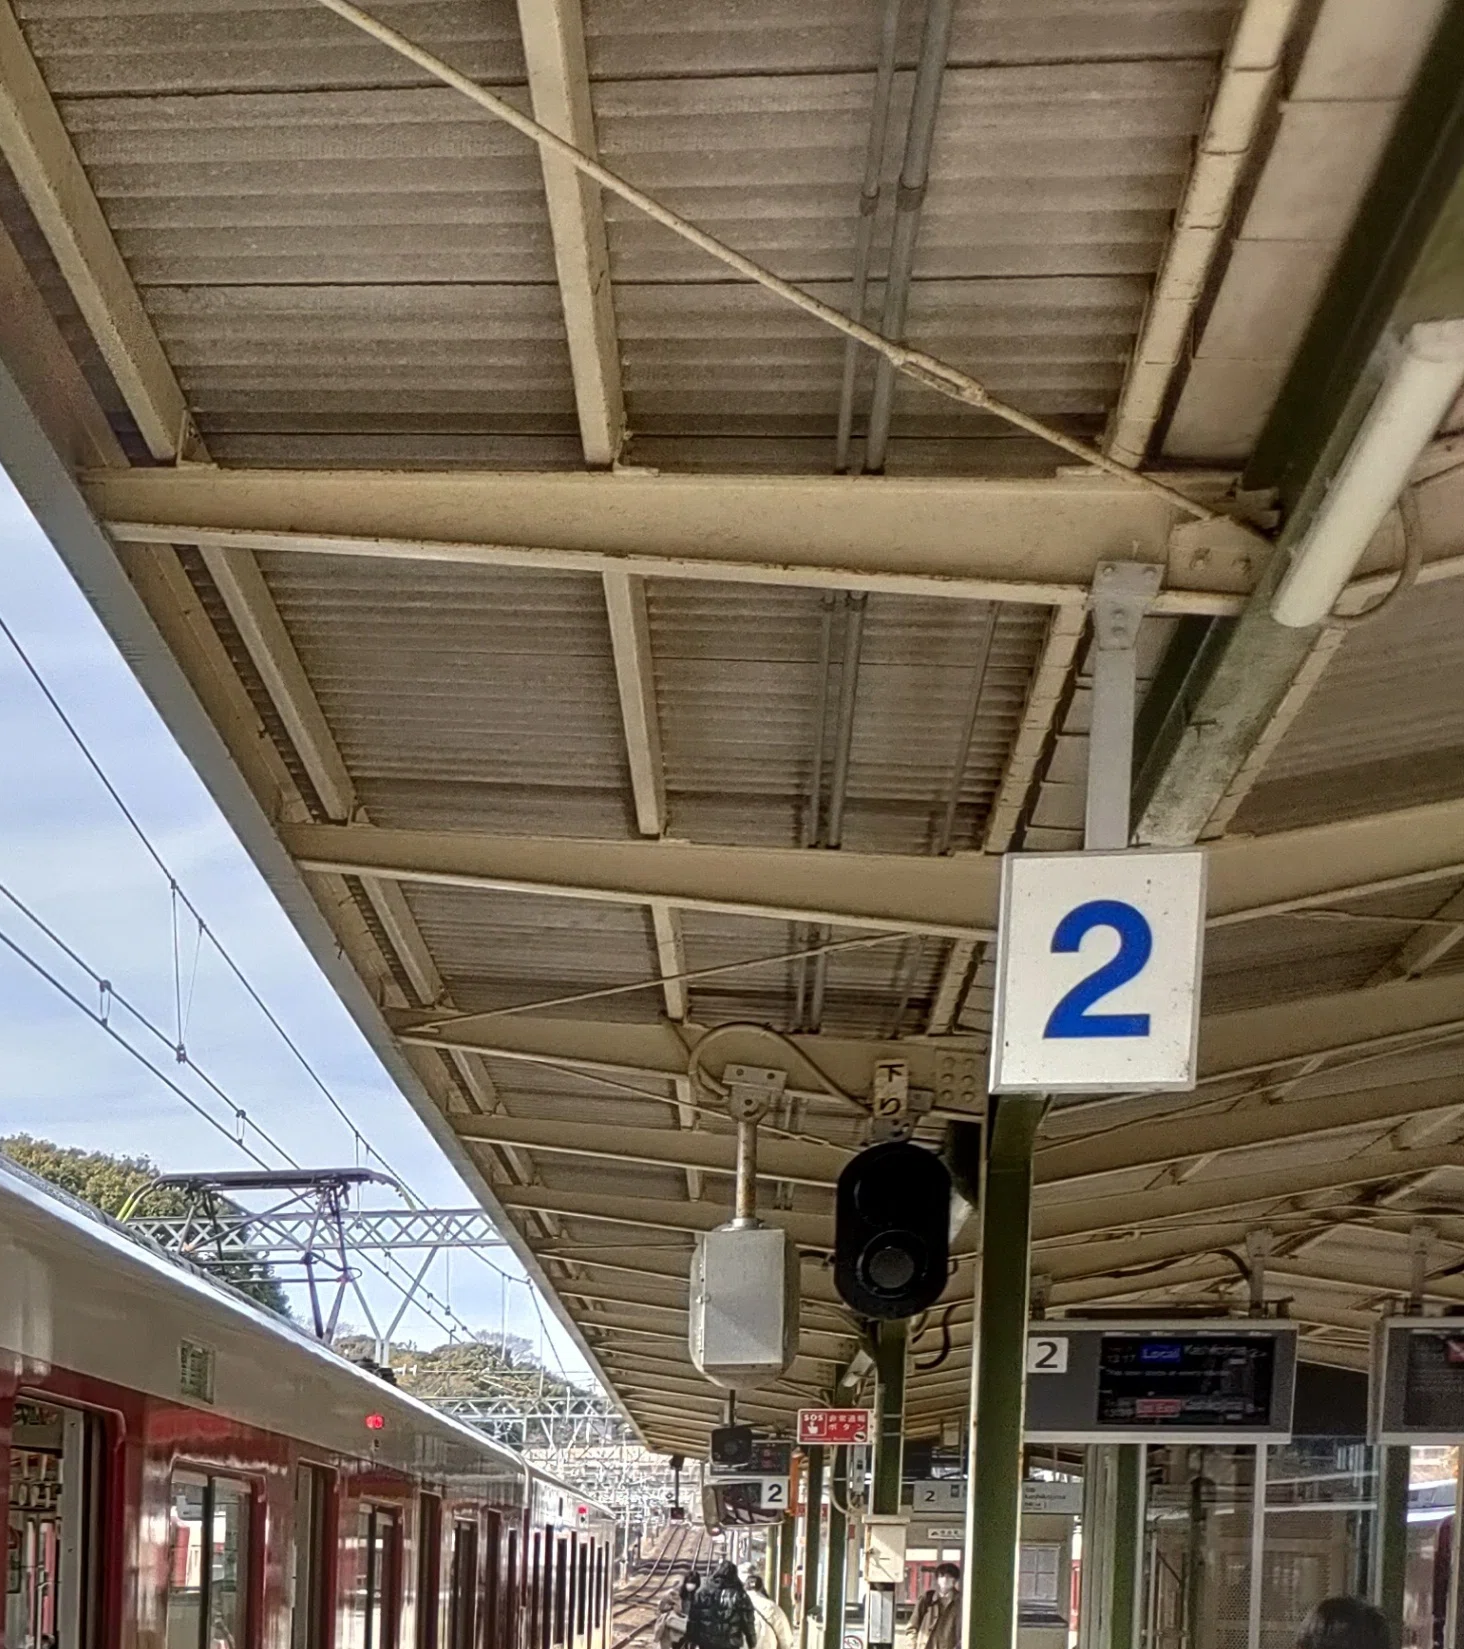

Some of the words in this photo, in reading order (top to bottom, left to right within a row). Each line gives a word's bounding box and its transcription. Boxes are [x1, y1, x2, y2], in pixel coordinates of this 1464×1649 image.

[1042, 899, 1153, 1039] 2
[878, 1063, 905, 1116] 下り
[1034, 1341, 1059, 1368] 2
[804, 1414, 824, 1422] SOS
[767, 1483, 783, 1502] 2
[924, 1490, 936, 1502] 2
